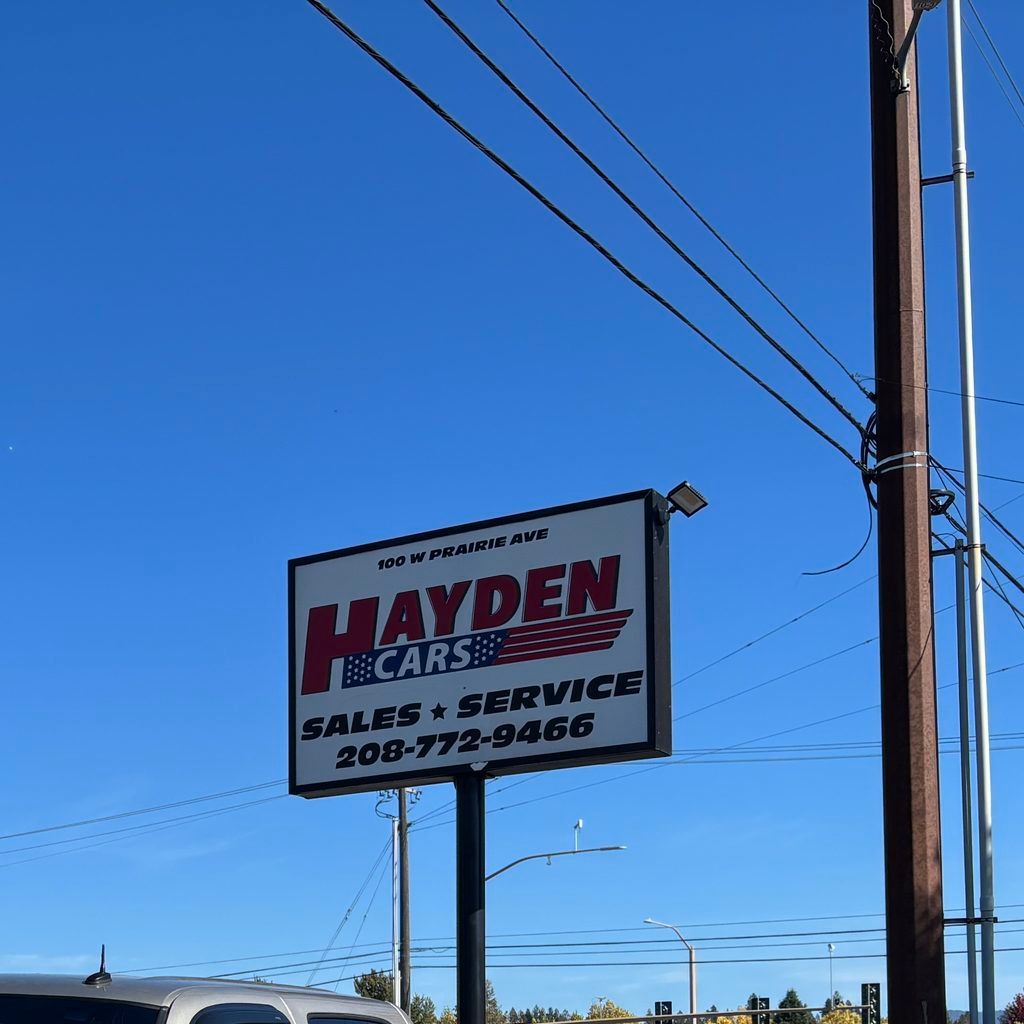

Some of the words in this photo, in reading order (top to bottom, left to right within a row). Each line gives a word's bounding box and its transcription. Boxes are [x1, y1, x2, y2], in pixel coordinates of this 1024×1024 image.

[377, 557, 406, 571] 100
[409, 551, 426, 565] W
[428, 535, 508, 562] PRAIRIE
[509, 527, 550, 545] AVE
[301, 554, 621, 696] HAYDEN
[373, 637, 473, 680] CARS
[301, 702, 423, 741] SALES
[457, 670, 645, 719] SERVICE
[335, 712, 596, 769] 208-772-9466
